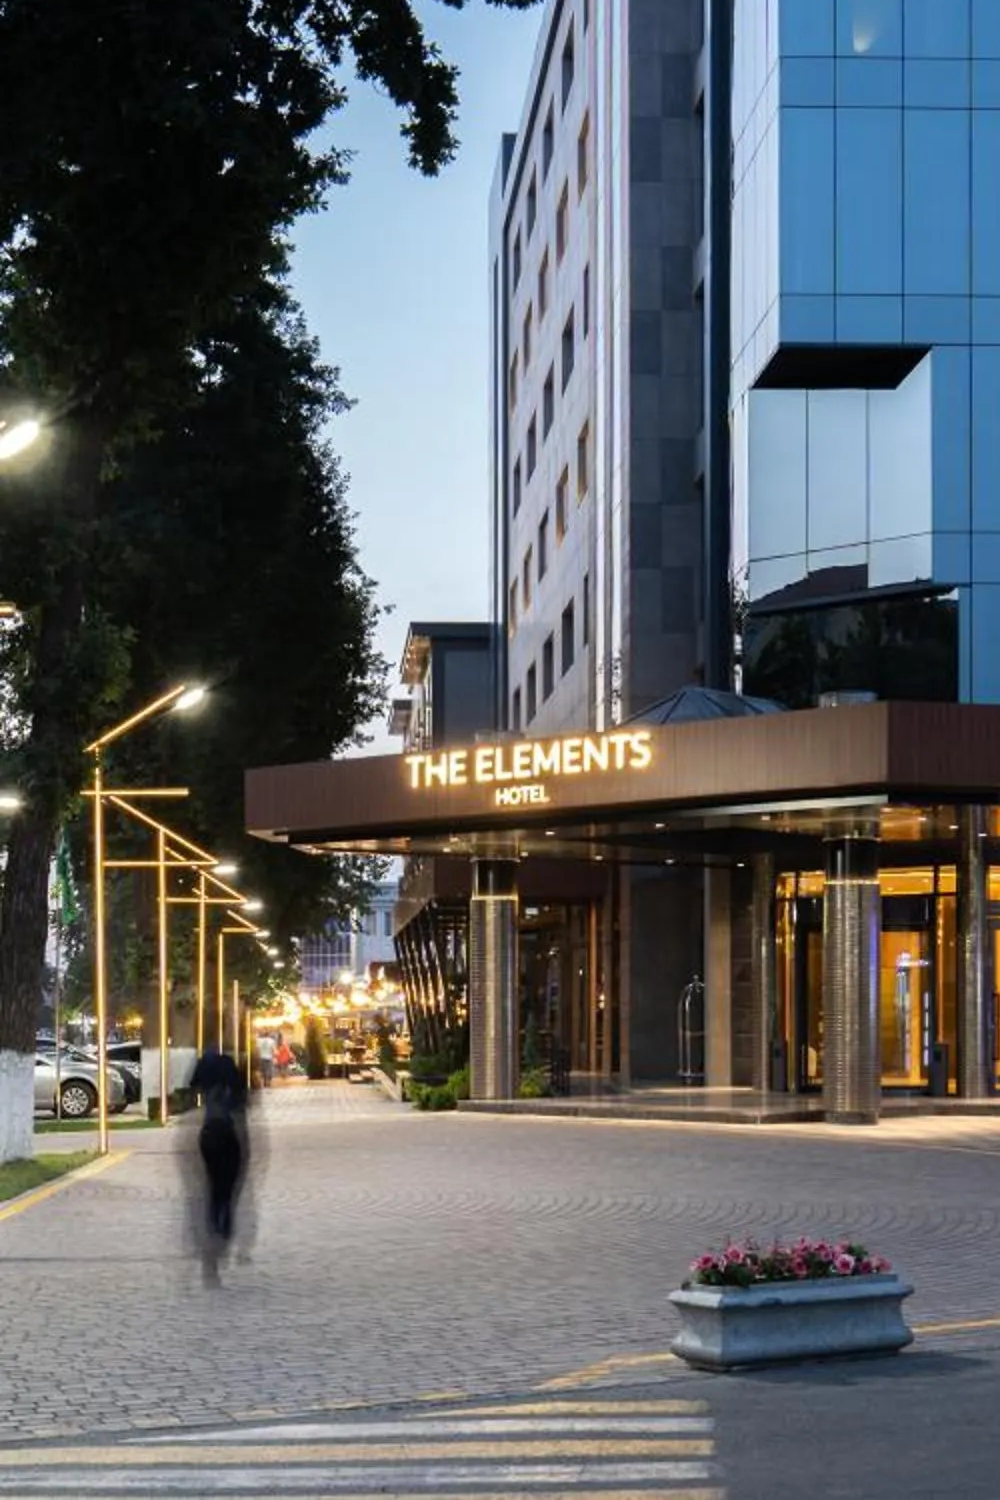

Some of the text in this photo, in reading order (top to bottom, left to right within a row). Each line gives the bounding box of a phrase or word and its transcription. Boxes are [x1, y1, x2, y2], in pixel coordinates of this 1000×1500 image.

[404, 732, 652, 790] THE ELEMENTS
[494, 784, 551, 806] HOTEL
